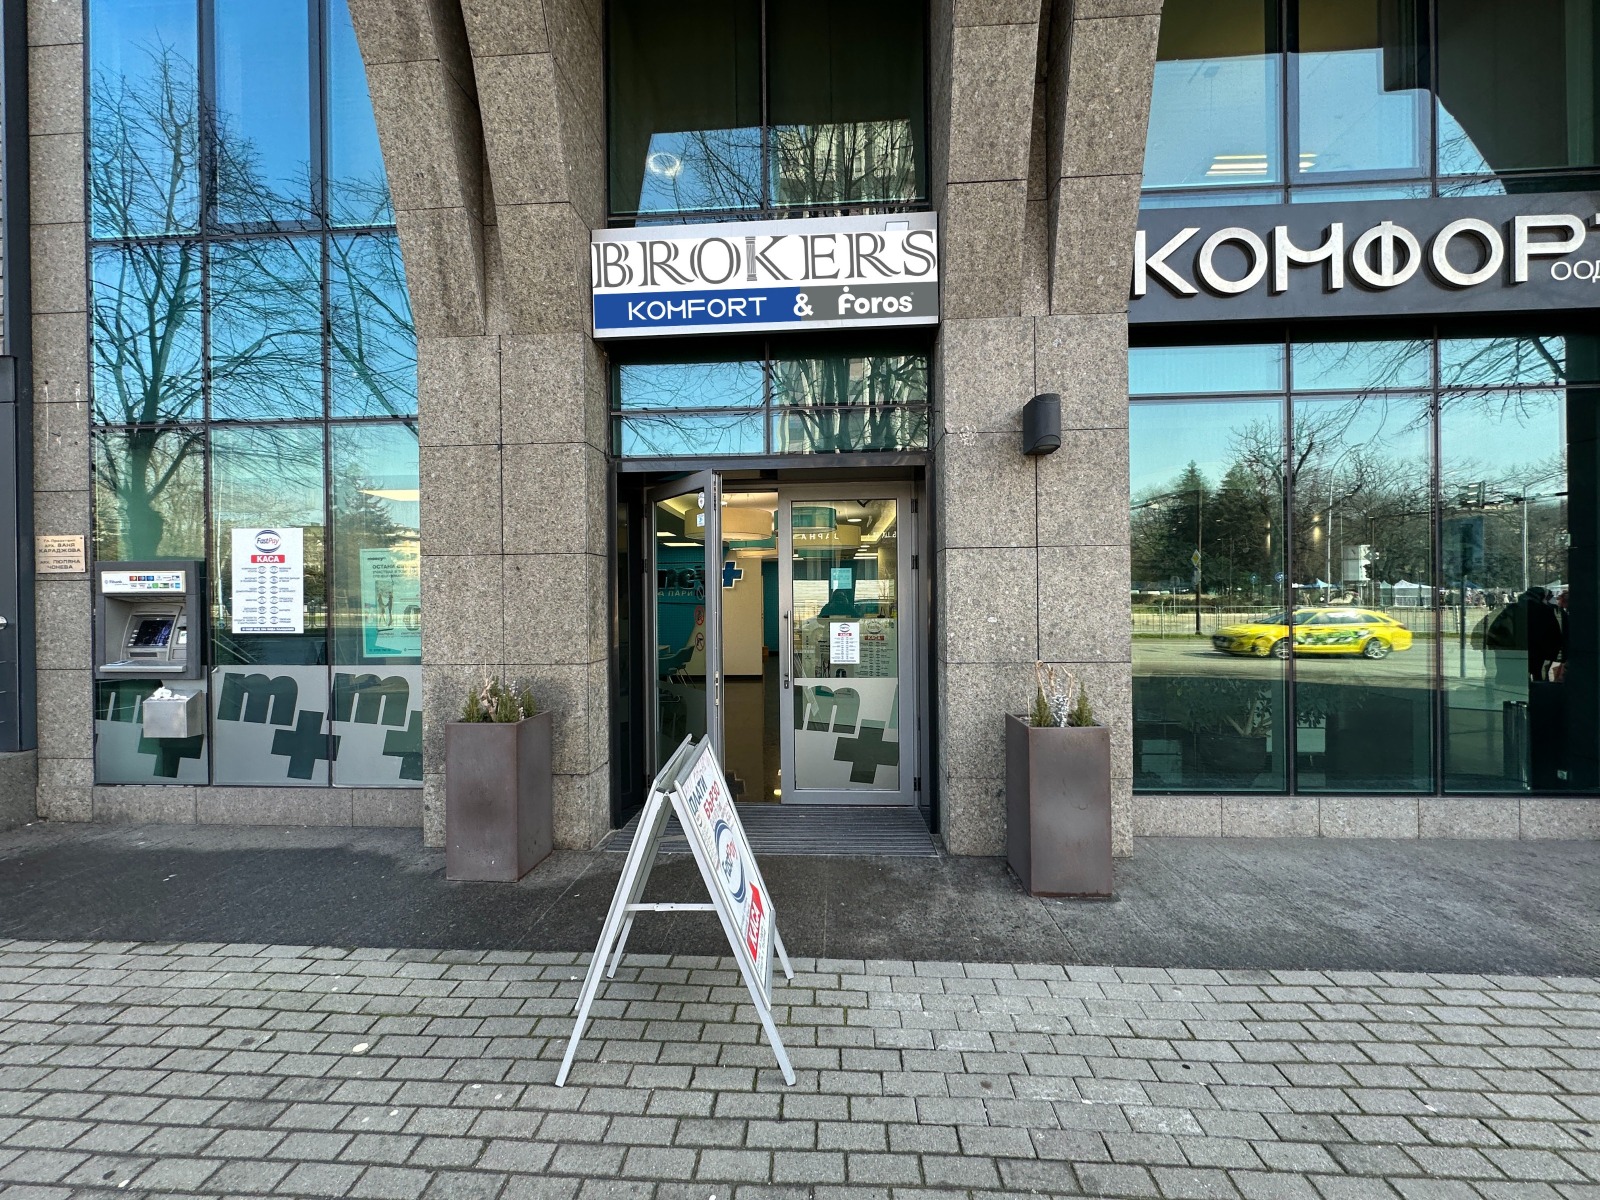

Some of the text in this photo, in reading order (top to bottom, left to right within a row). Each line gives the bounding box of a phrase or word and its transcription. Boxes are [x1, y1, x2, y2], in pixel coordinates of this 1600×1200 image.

[591, 230, 937, 288] BROKERS
[1134, 213, 1600, 296] КОМФОР
[628, 296, 767, 321] KOMFORT
[793, 293, 814, 317] &
[256, 537, 280, 546] FastPay
[256, 555, 280, 563] КАСА
[747, 901, 761, 949] КАСА
